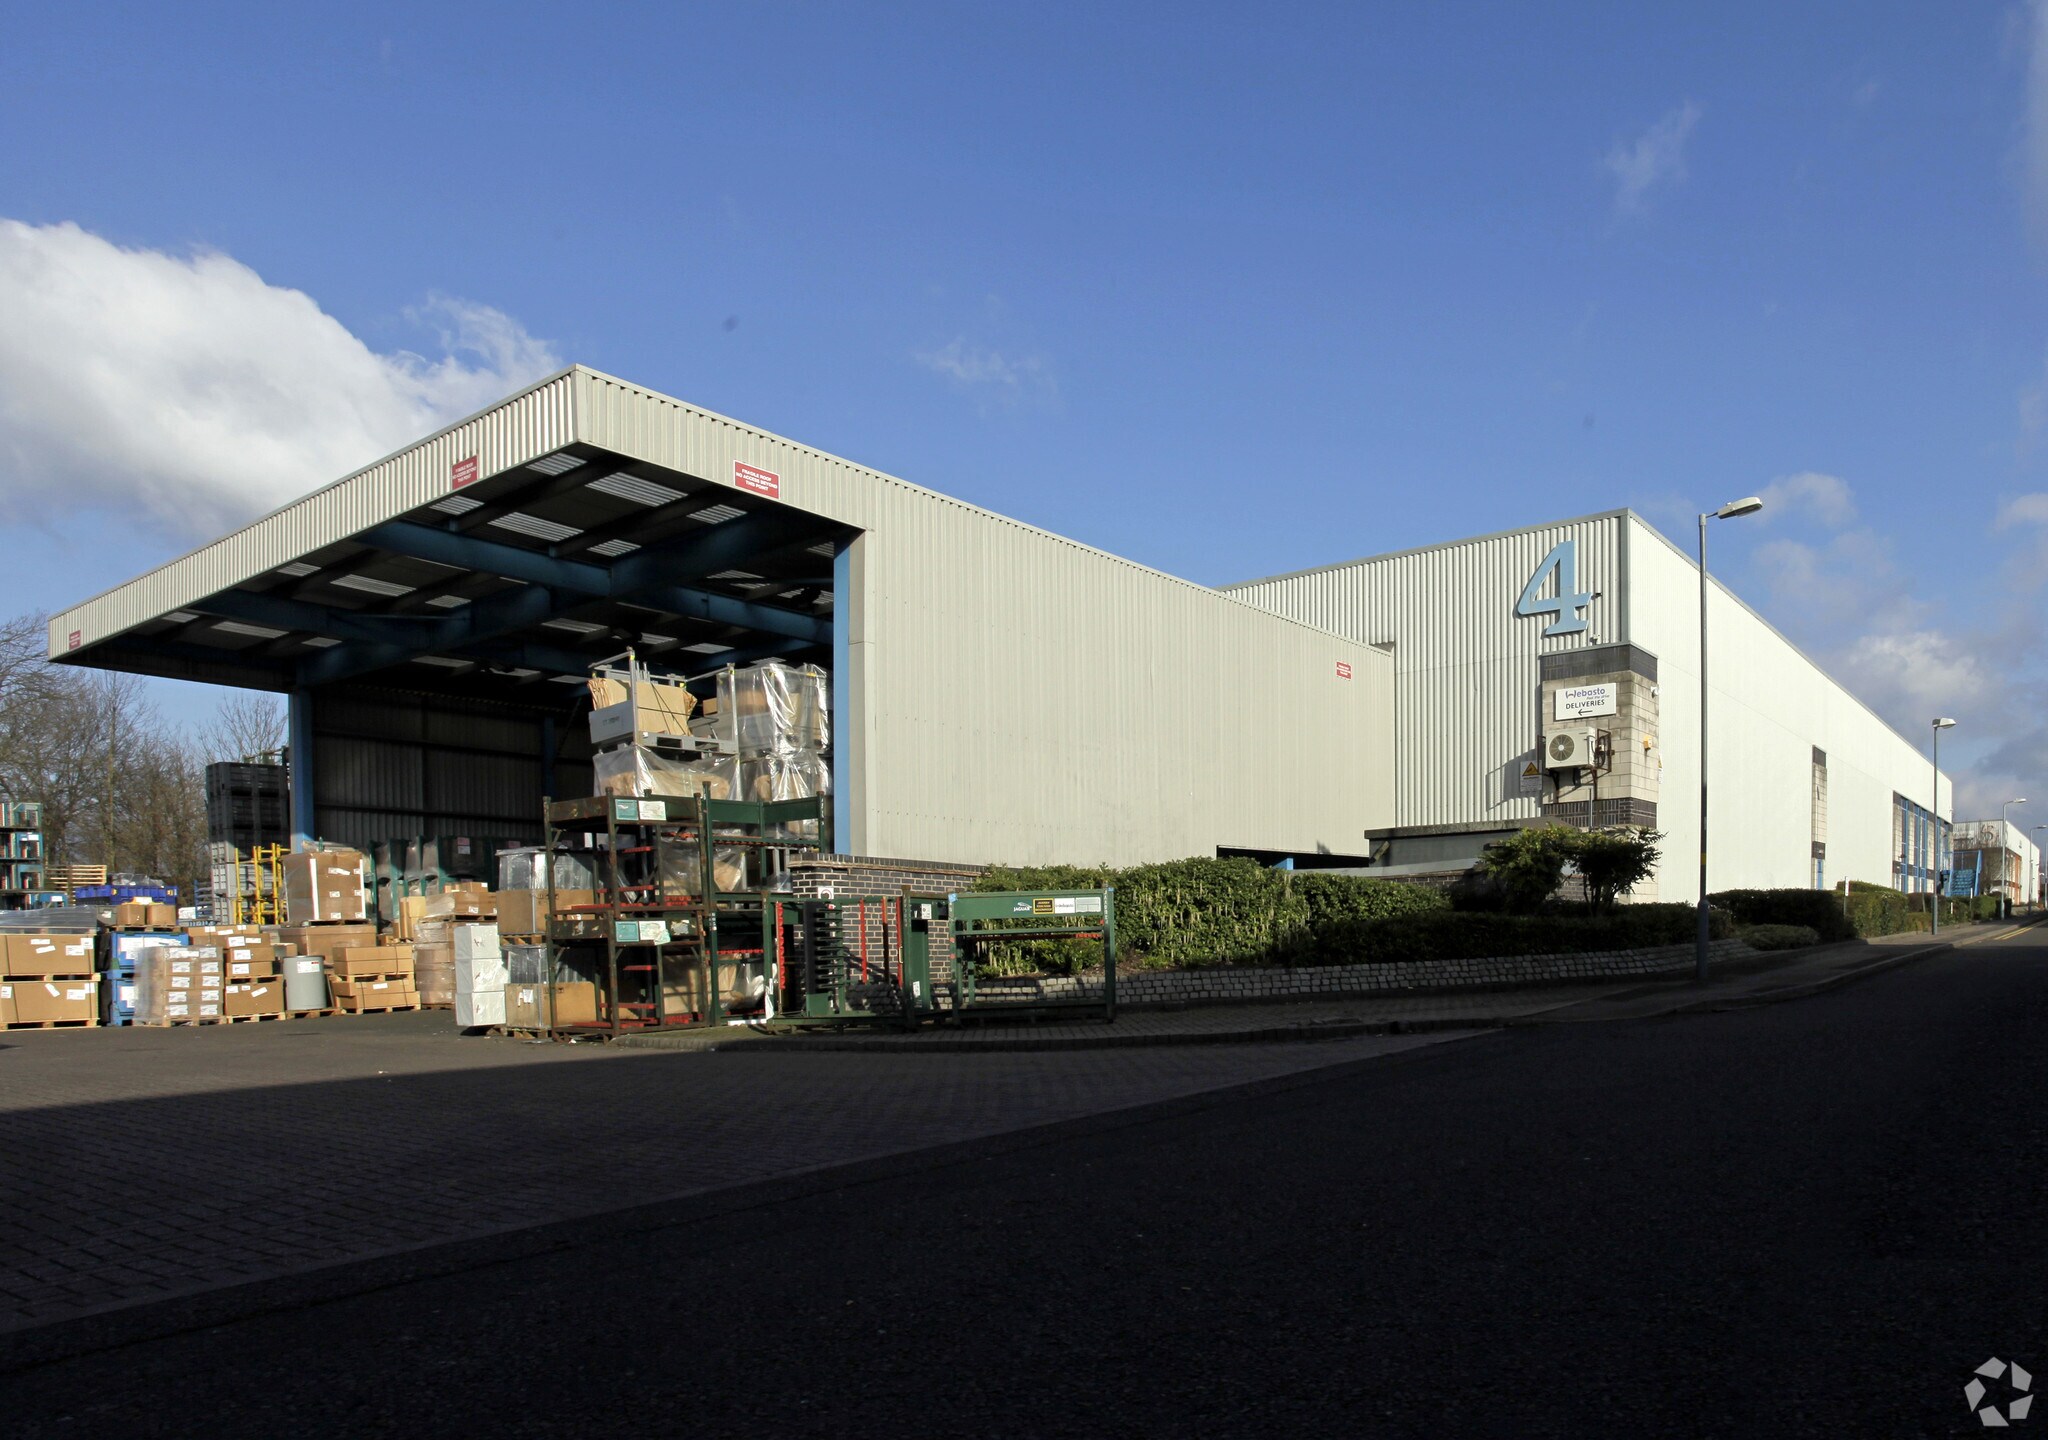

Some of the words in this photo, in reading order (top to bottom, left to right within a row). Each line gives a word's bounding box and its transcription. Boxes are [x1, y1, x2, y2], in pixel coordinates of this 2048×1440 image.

[1518, 540, 1593, 635] 4
[1565, 687, 1606, 699] Webasto
[1565, 699, 1605, 709] DELIVERIES
